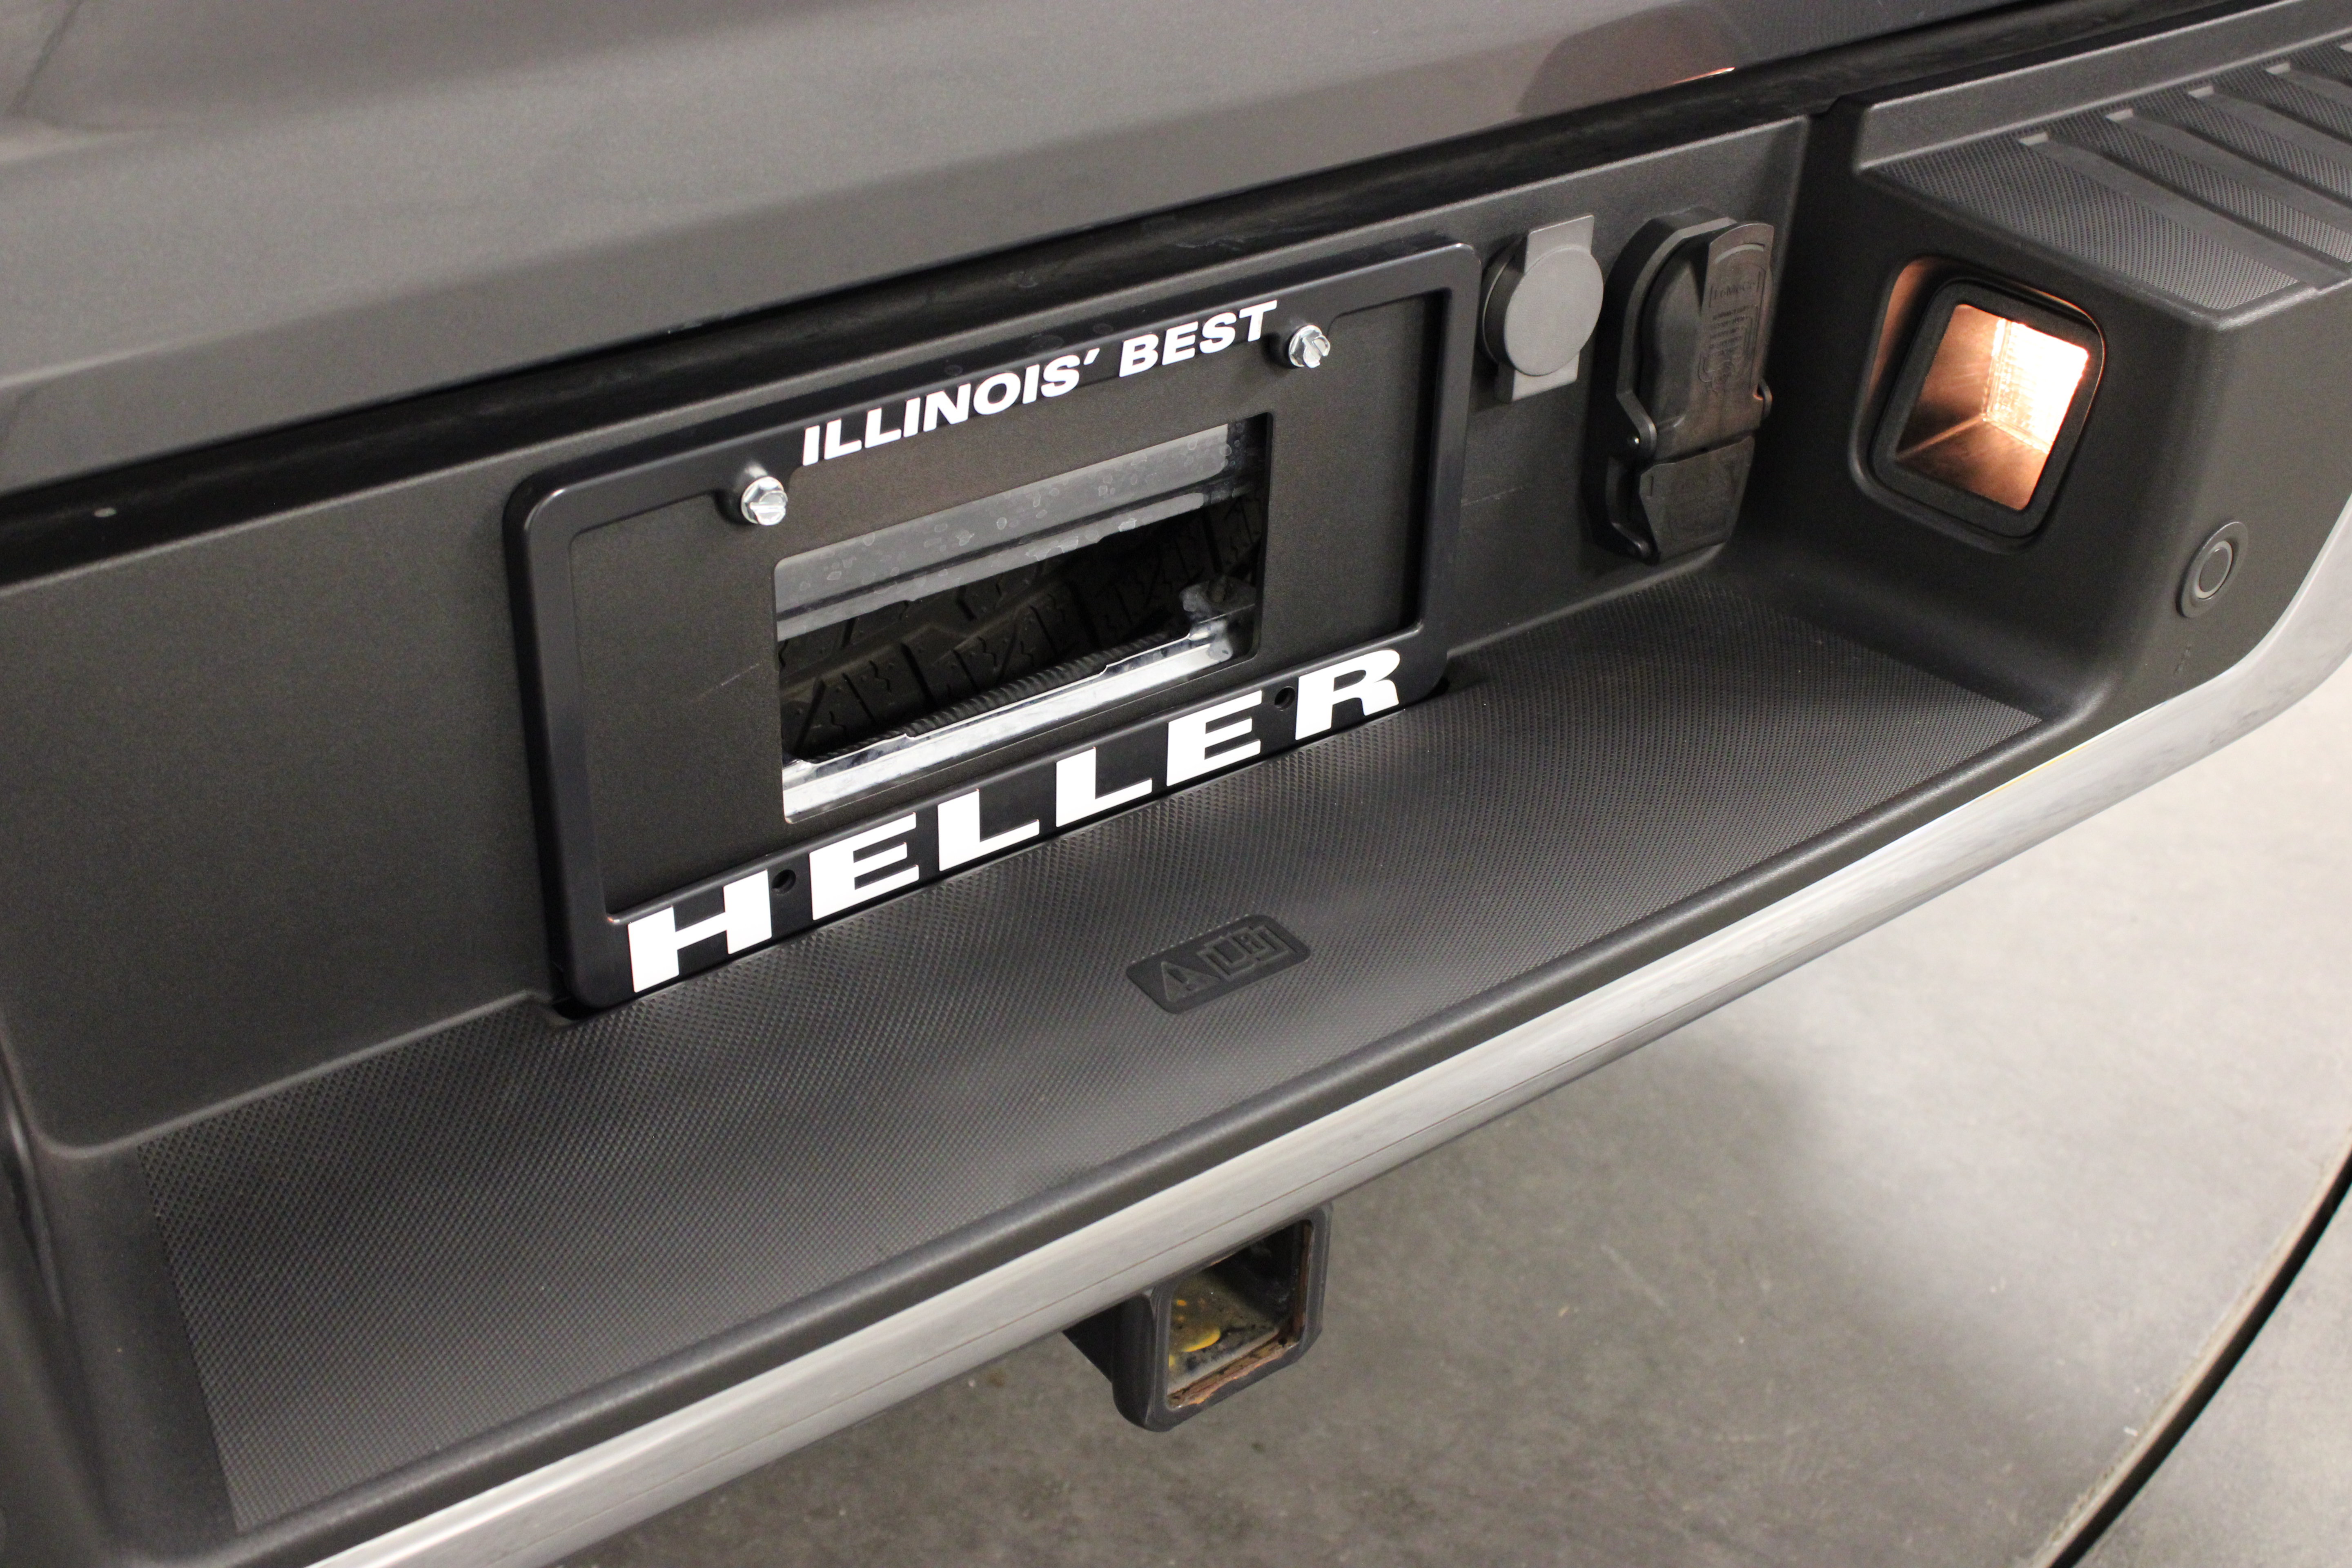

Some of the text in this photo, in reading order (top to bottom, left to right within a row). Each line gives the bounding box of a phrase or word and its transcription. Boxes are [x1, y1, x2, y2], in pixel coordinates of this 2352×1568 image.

[802, 299, 1278, 466] ILLINOIS' BEST
[627, 648, 1401, 993] HELLER
